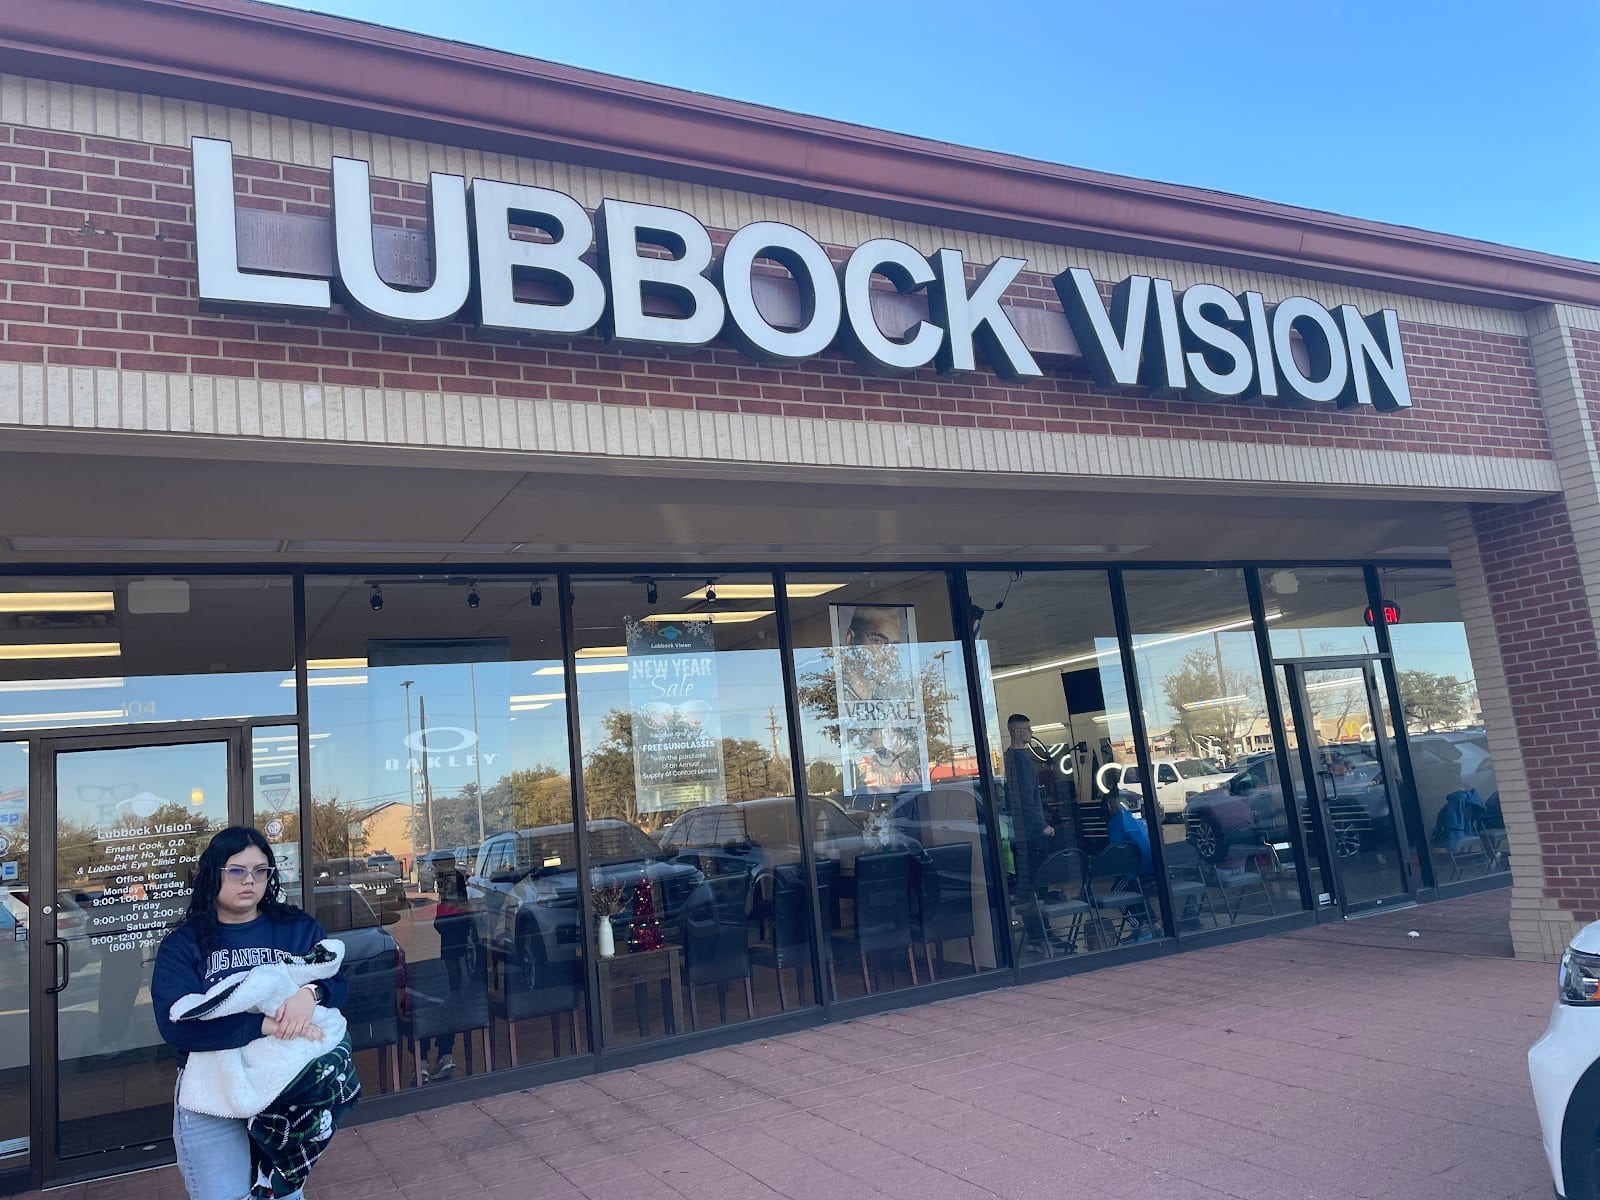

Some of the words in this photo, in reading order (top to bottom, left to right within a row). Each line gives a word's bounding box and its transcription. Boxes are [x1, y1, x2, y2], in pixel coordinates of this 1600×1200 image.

[191, 135, 1043, 377] LUBBOCK
[1055, 267, 1413, 411] VISION
[1368, 606, 1398, 624] EN
[632, 659, 668, 680] NEW
[671, 657, 712, 677] YEAR
[650, 674, 695, 699] Sale
[844, 701, 917, 721] VERSACE
[642, 743, 663, 753] FREE
[663, 740, 716, 751] SUNGLASSES
[385, 753, 496, 771] OAKLEY
[678, 760, 700, 768] Annual
[672, 769, 697, 777] Contact
[97, 825, 151, 840] Lubbock
[154, 822, 192, 834] Vision
[105, 844, 136, 854] Ernest
[168, 838, 187, 847] O.D.
[113, 853, 139, 863] Peter
[159, 848, 178, 857] M.D.
[76, 867, 84, 875] &
[87, 863, 128, 874] Lubbock
[131, 861, 148, 870] Eye
[151, 857, 176, 867] Clinic
[115, 875, 144, 885] Office
[147, 871, 177, 881] Hours:
[103, 880, 185, 897] Monday-Thursday
[92, 895, 139, 907] 9:00-1:00
[142, 892, 149, 901] &
[152, 887, 194, 899] 2:00-6:0
[132, 902, 161, 912] Friday
[93, 913, 139, 926] 9:00-1:00
[142, 911, 149, 920] &
[126, 920, 167, 932] Saturday
[91, 932, 142, 945] 9:00-12:00
[146, 930, 153, 938] &
[109, 941, 135, 953] (806)
[205, 949, 229, 979] LOS
